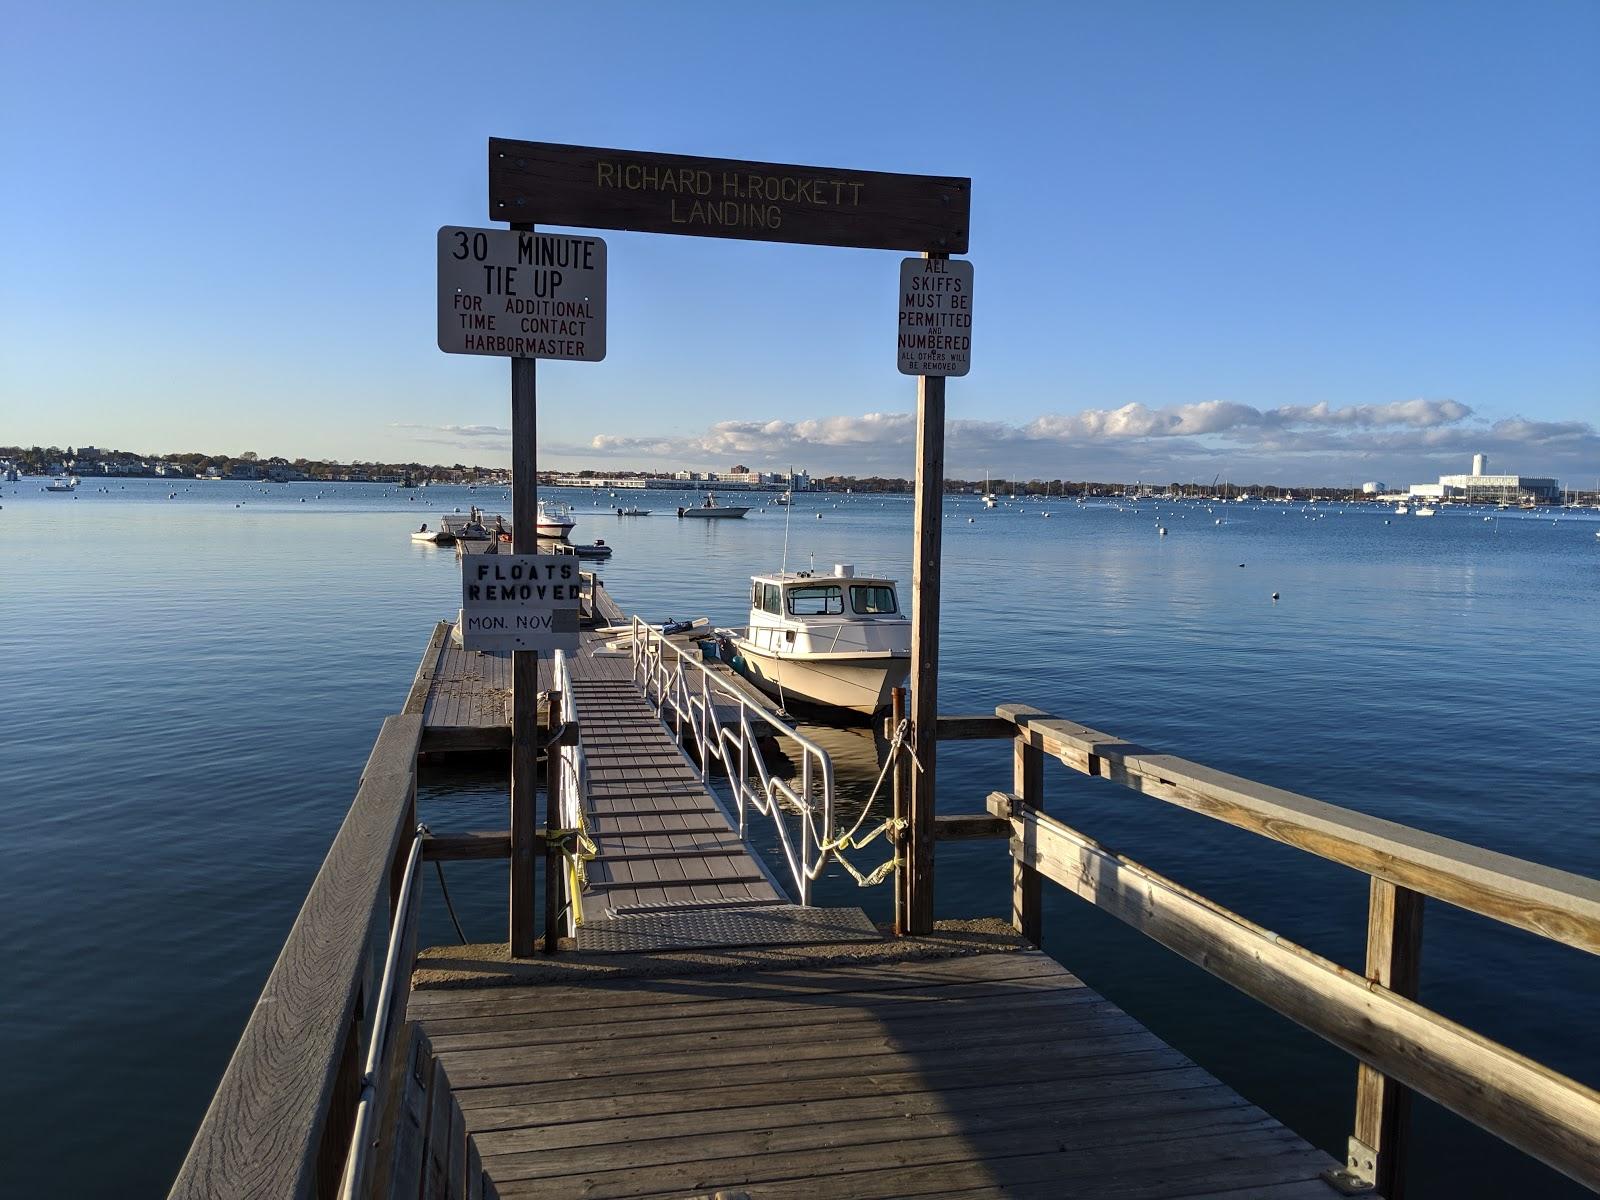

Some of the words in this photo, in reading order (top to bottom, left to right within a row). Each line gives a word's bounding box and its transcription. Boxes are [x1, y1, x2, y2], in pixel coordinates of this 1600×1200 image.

[597, 162, 712, 196] RICHARD
[670, 199, 782, 229] LANDING
[453, 231, 488, 261] 30
[518, 236, 595, 270] MINUTE
[483, 265, 517, 296] TIE
[534, 269, 563, 298] UP
[912, 276, 962, 292] SKIFFS
[454, 294, 482, 311] FOR
[505, 298, 594, 319] ADDITIONAL
[905, 293, 943, 308] MUST
[951, 295, 968, 309] BE
[459, 313, 496, 330] TIME
[521, 318, 586, 336] CONTACT
[898, 312, 971, 328] PERMITTED
[928, 327, 942, 335] AND
[465, 334, 585, 356] HARBORMASTER
[898, 334, 970, 350] NUMBERED
[902, 352, 915, 360] ALL
[918, 353, 946, 361] OTHERS
[951, 354, 966, 362] WILL
[909, 361, 919, 369] BE
[923, 362, 956, 371] REMOVED
[478, 565, 572, 580] FLOATS
[468, 585, 580, 600] REMOVED
[468, 616, 508, 630] MON.
